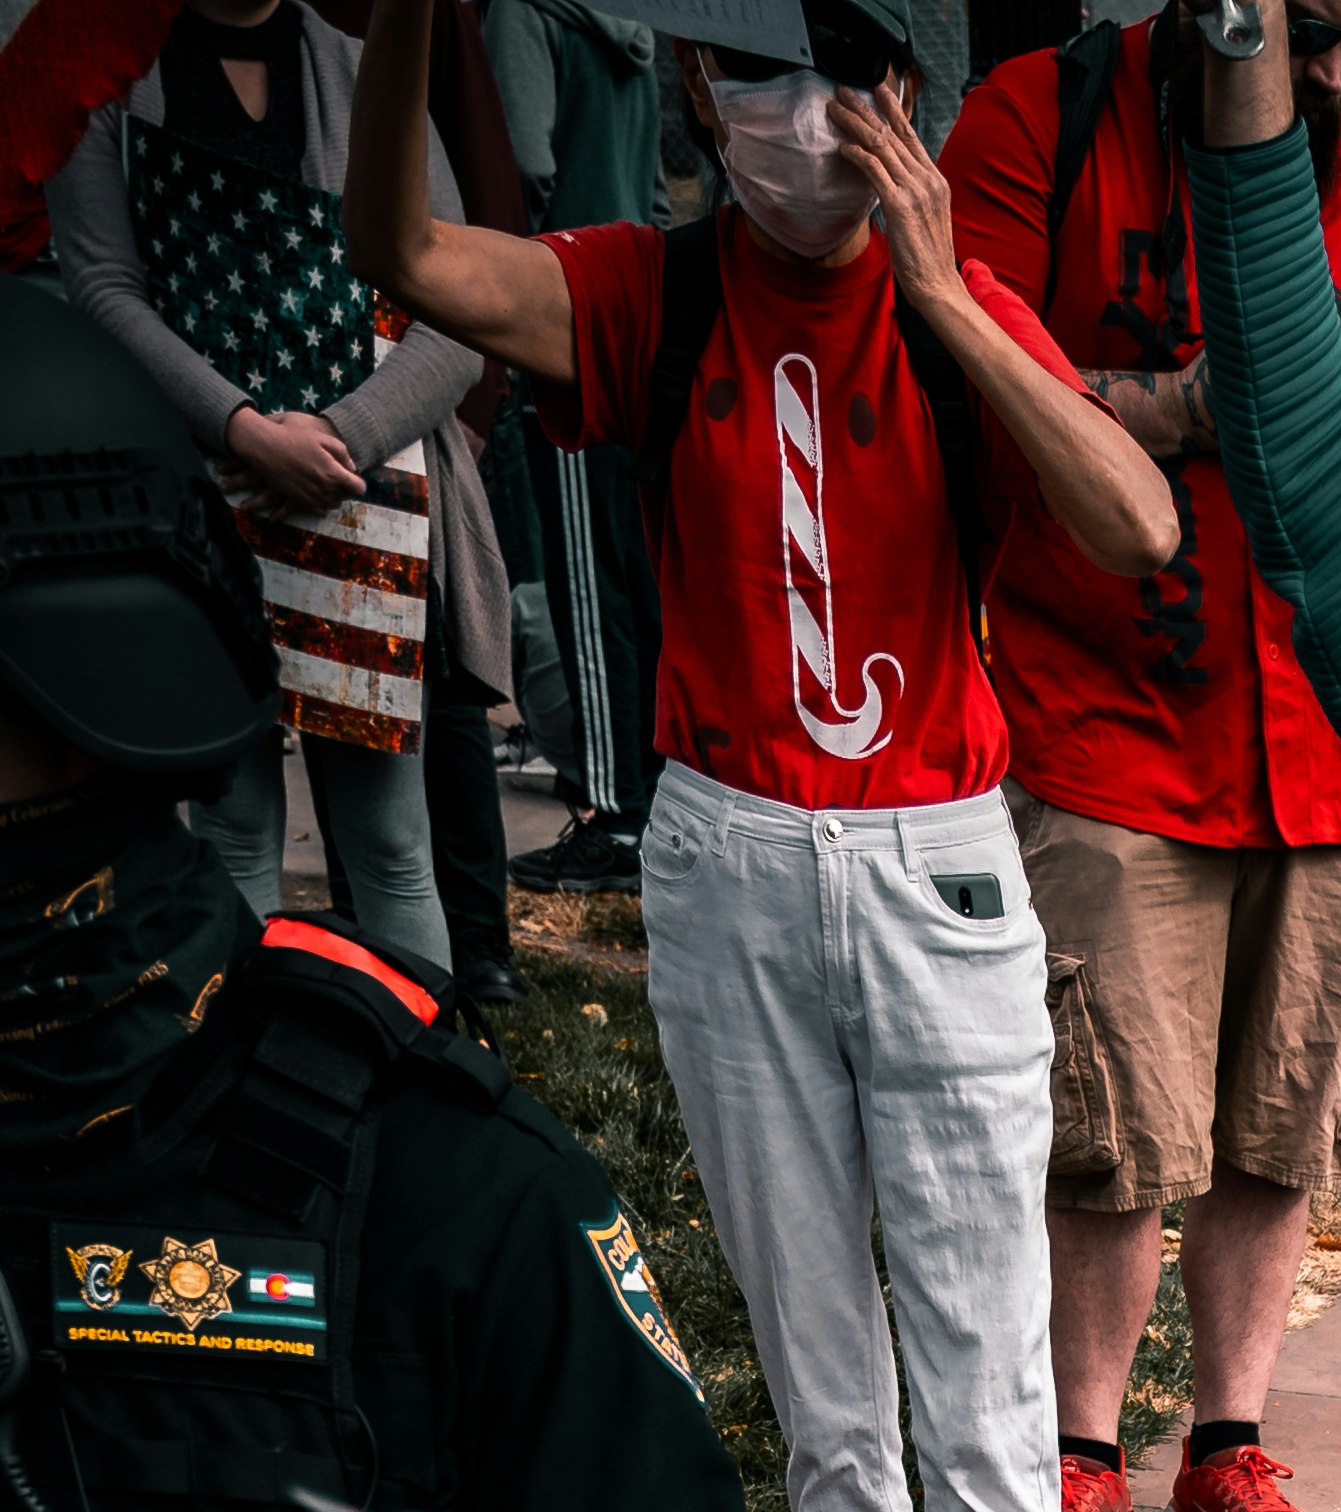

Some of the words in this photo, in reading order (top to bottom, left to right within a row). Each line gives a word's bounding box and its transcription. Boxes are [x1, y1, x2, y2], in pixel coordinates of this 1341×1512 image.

[68, 1326, 130, 1342] SPECIAL
[132, 1329, 195, 1346] TACTICS
[198, 1334, 233, 1350] AND
[235, 1337, 315, 1357] RESPONSE
